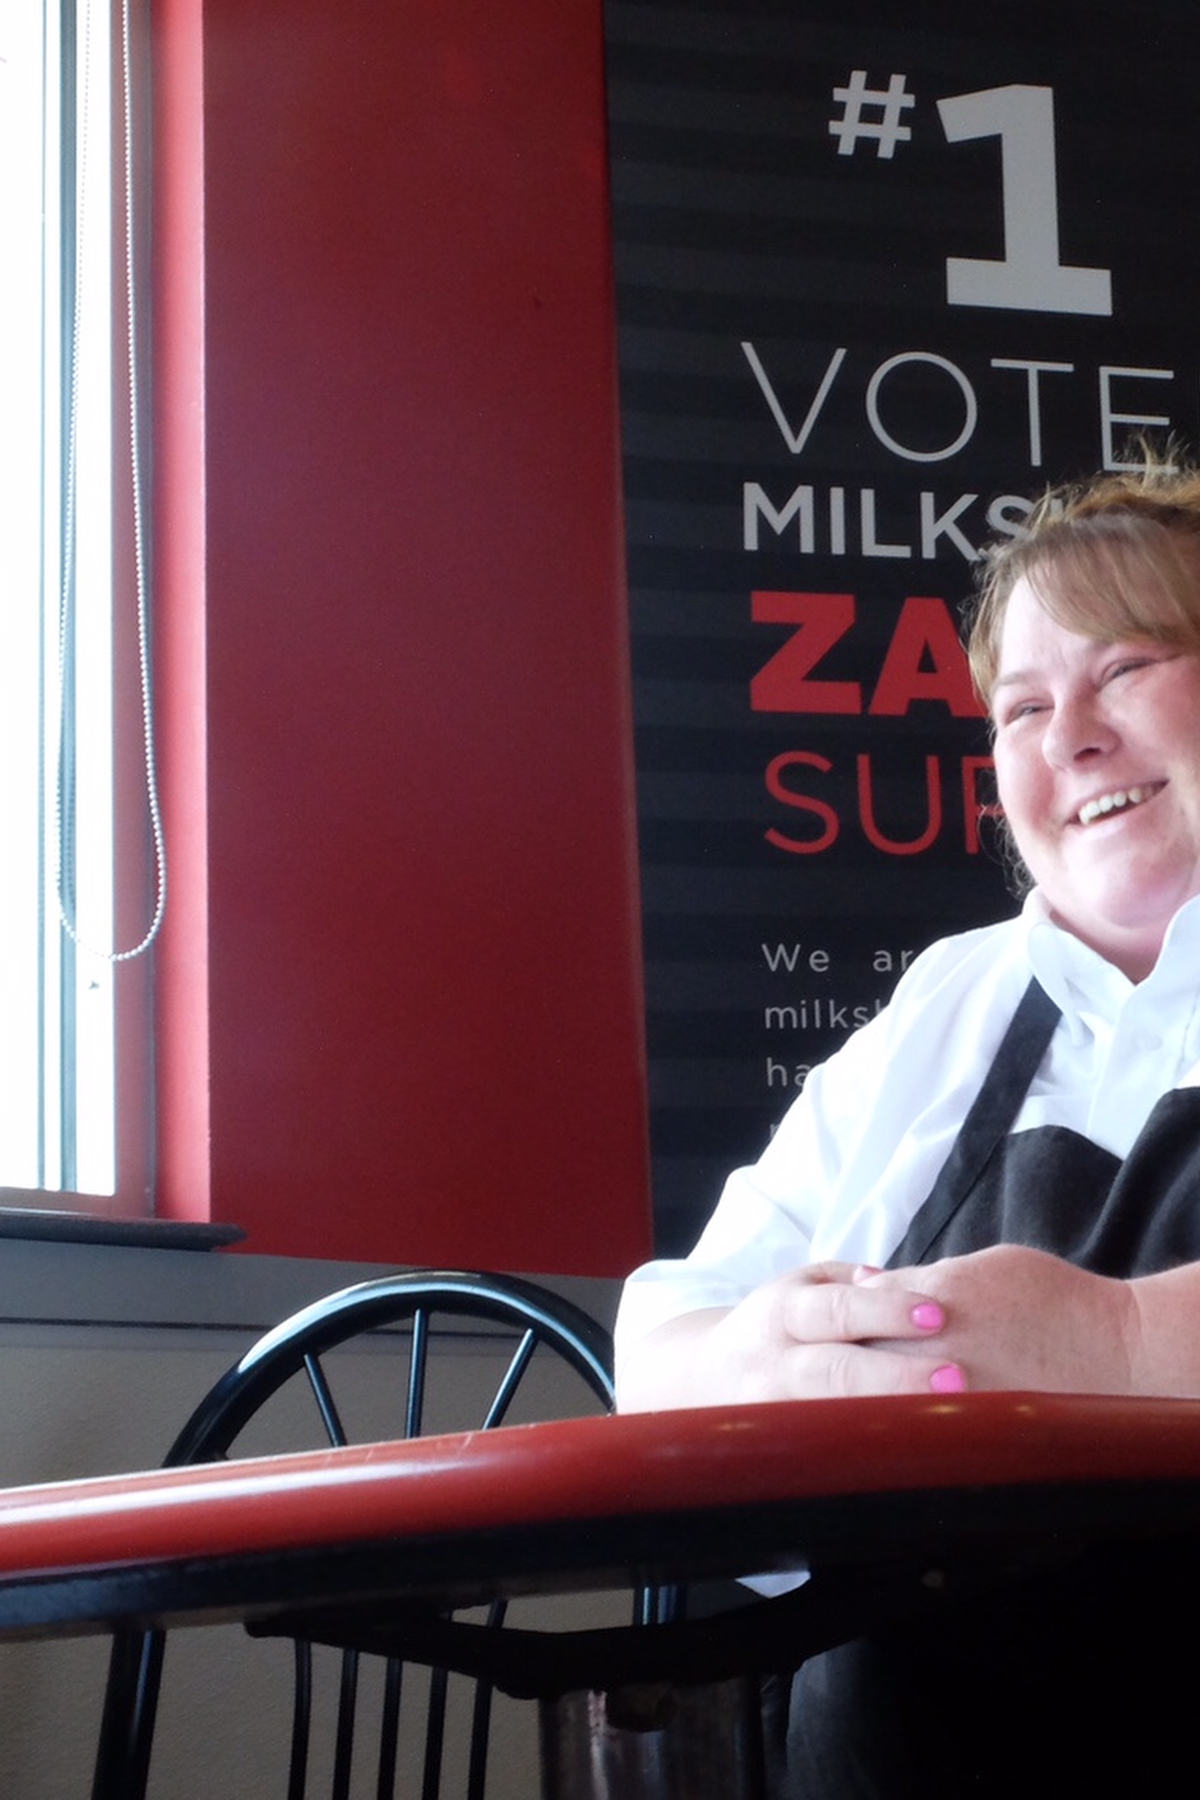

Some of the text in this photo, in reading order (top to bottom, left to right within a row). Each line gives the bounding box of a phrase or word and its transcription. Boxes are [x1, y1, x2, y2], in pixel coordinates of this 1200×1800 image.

[828, 70, 1112, 316] #1
[750, 590, 988, 718] ZA
[761, 943, 915, 972] We ar
